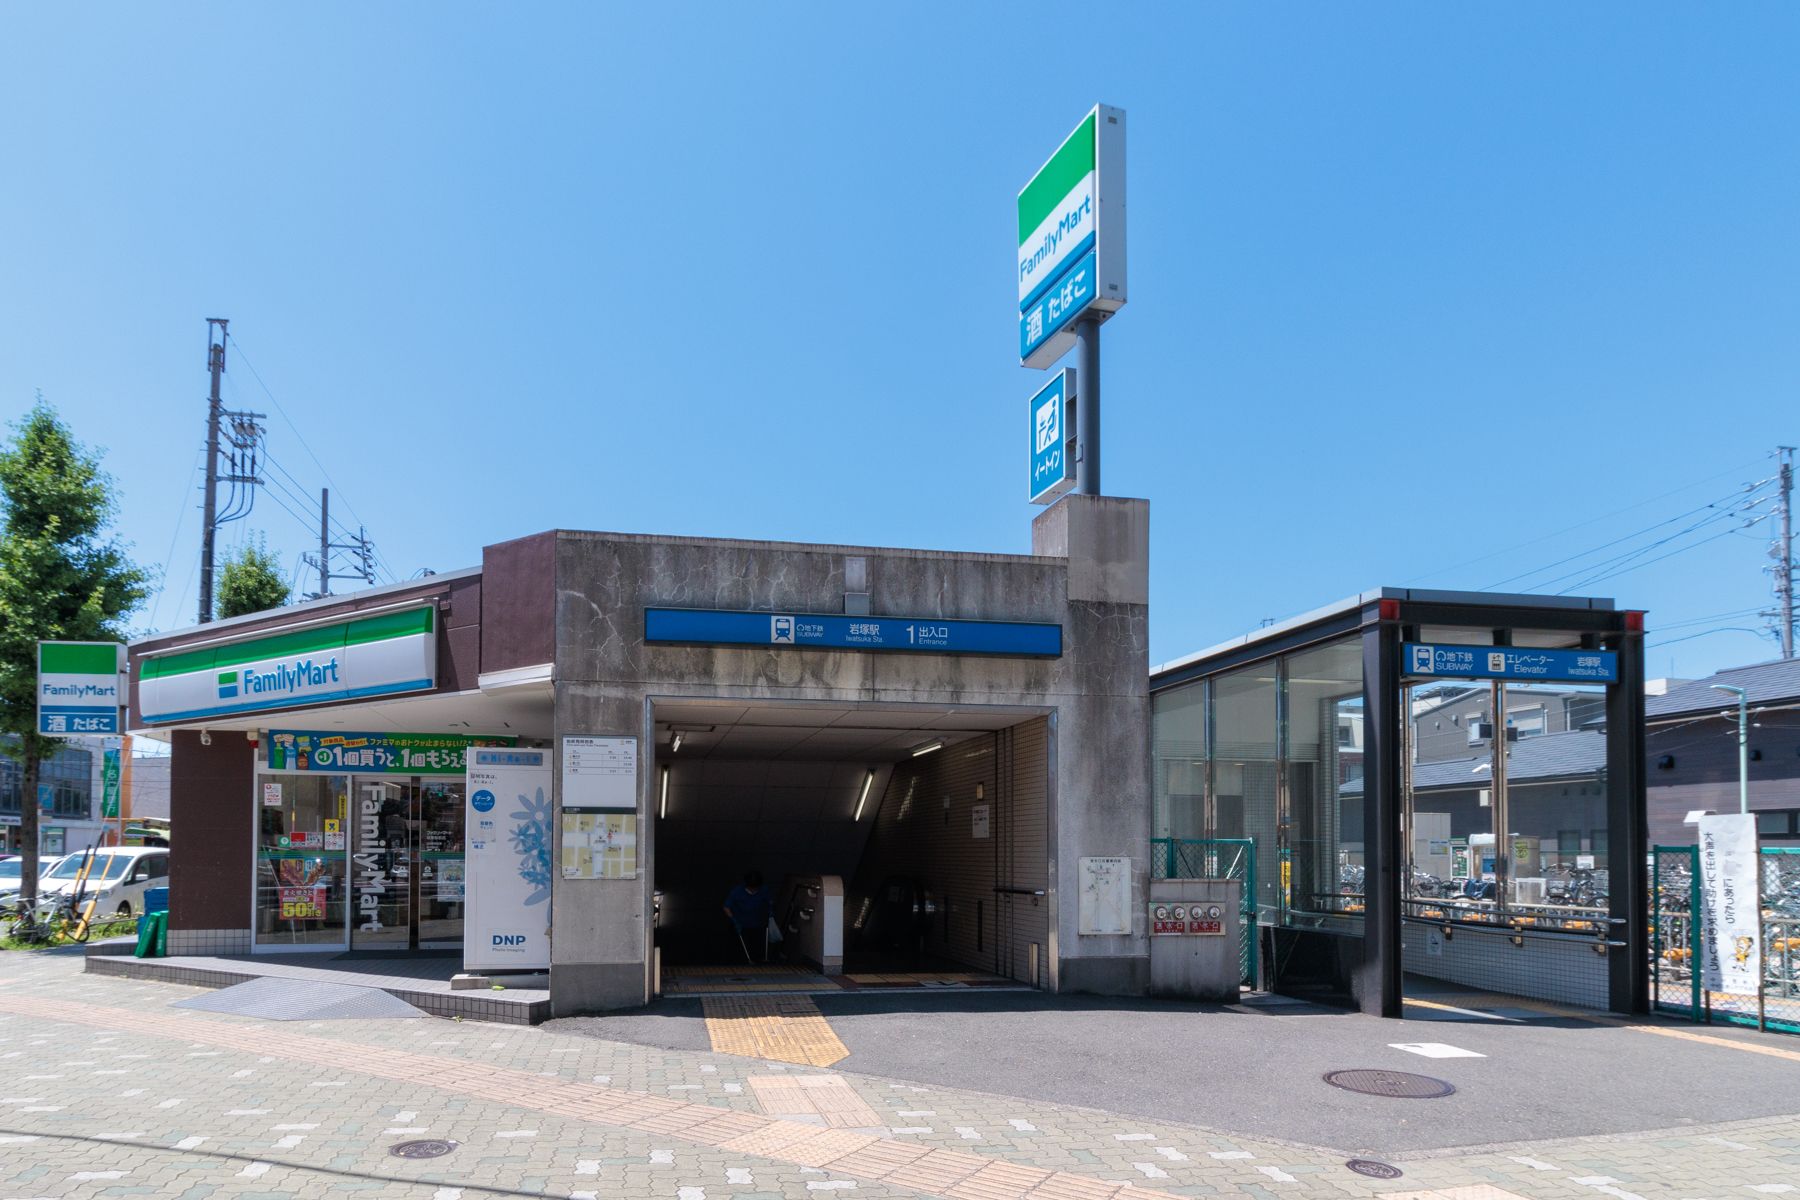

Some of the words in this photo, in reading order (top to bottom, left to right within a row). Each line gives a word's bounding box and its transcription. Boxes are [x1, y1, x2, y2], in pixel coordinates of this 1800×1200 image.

[1020, 193, 1091, 282] FamilyMart
[1026, 304, 1043, 346] 酒
[1048, 269, 1087, 323] たばこ
[1035, 450, 1060, 481] イートイン
[849, 623, 880, 636] 岩塚駅
[906, 625, 914, 644] 1
[918, 626, 948, 638] 出入口
[846, 635, 872, 643] Iwatsuka
[918, 637, 948, 645] Entrance
[1446, 652, 1474, 662] 地下鉄
[1507, 654, 1555, 664] エレベーター
[1577, 656, 1601, 667] 岩塚駅
[1435, 662, 1474, 671] SUBWAY
[1514, 664, 1547, 674] Elevator
[1568, 667, 1597, 676] Iwatsuka
[1597, 667, 1610, 677] Sta.
[244, 656, 339, 694] FamilyMart
[43, 684, 115, 698] FamilyMart
[47, 715, 67, 732] 酒
[73, 717, 111, 731] たばこ
[354, 785, 387, 933] FamilyMart
[1723, 878, 1736, 924] にあったら
[492, 935, 526, 946] DNP
